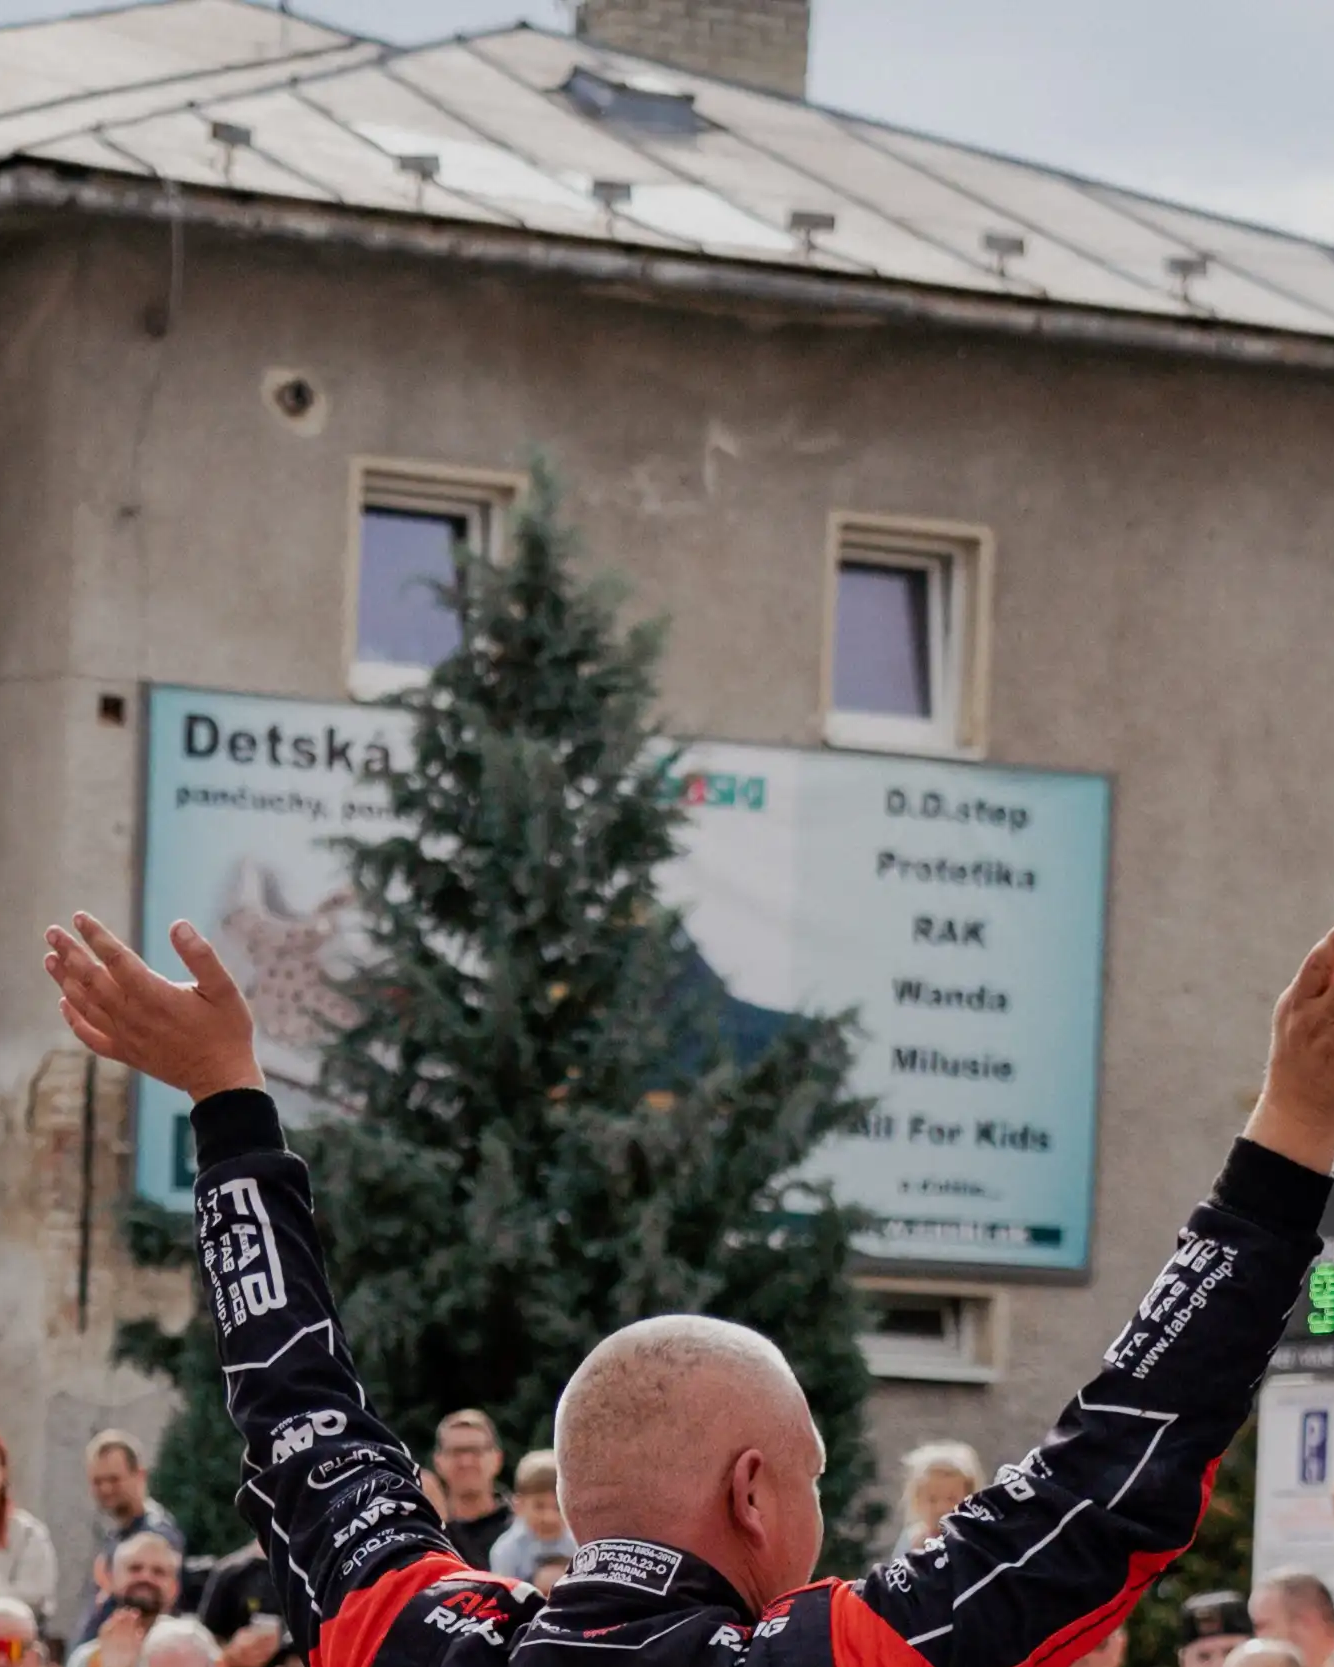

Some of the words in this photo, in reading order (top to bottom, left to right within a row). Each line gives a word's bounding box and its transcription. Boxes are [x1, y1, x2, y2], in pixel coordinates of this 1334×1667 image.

[183, 711, 392, 777] Detská
[912, 915, 989, 949] RAK
[892, 978, 1010, 1014] Wanda
[891, 1048, 1015, 1082] Milusie
[908, 1113, 963, 1146] For
[974, 1118, 1054, 1151] Kids
[217, 1231, 236, 1275] FAB
[219, 1177, 288, 1316] FAB
